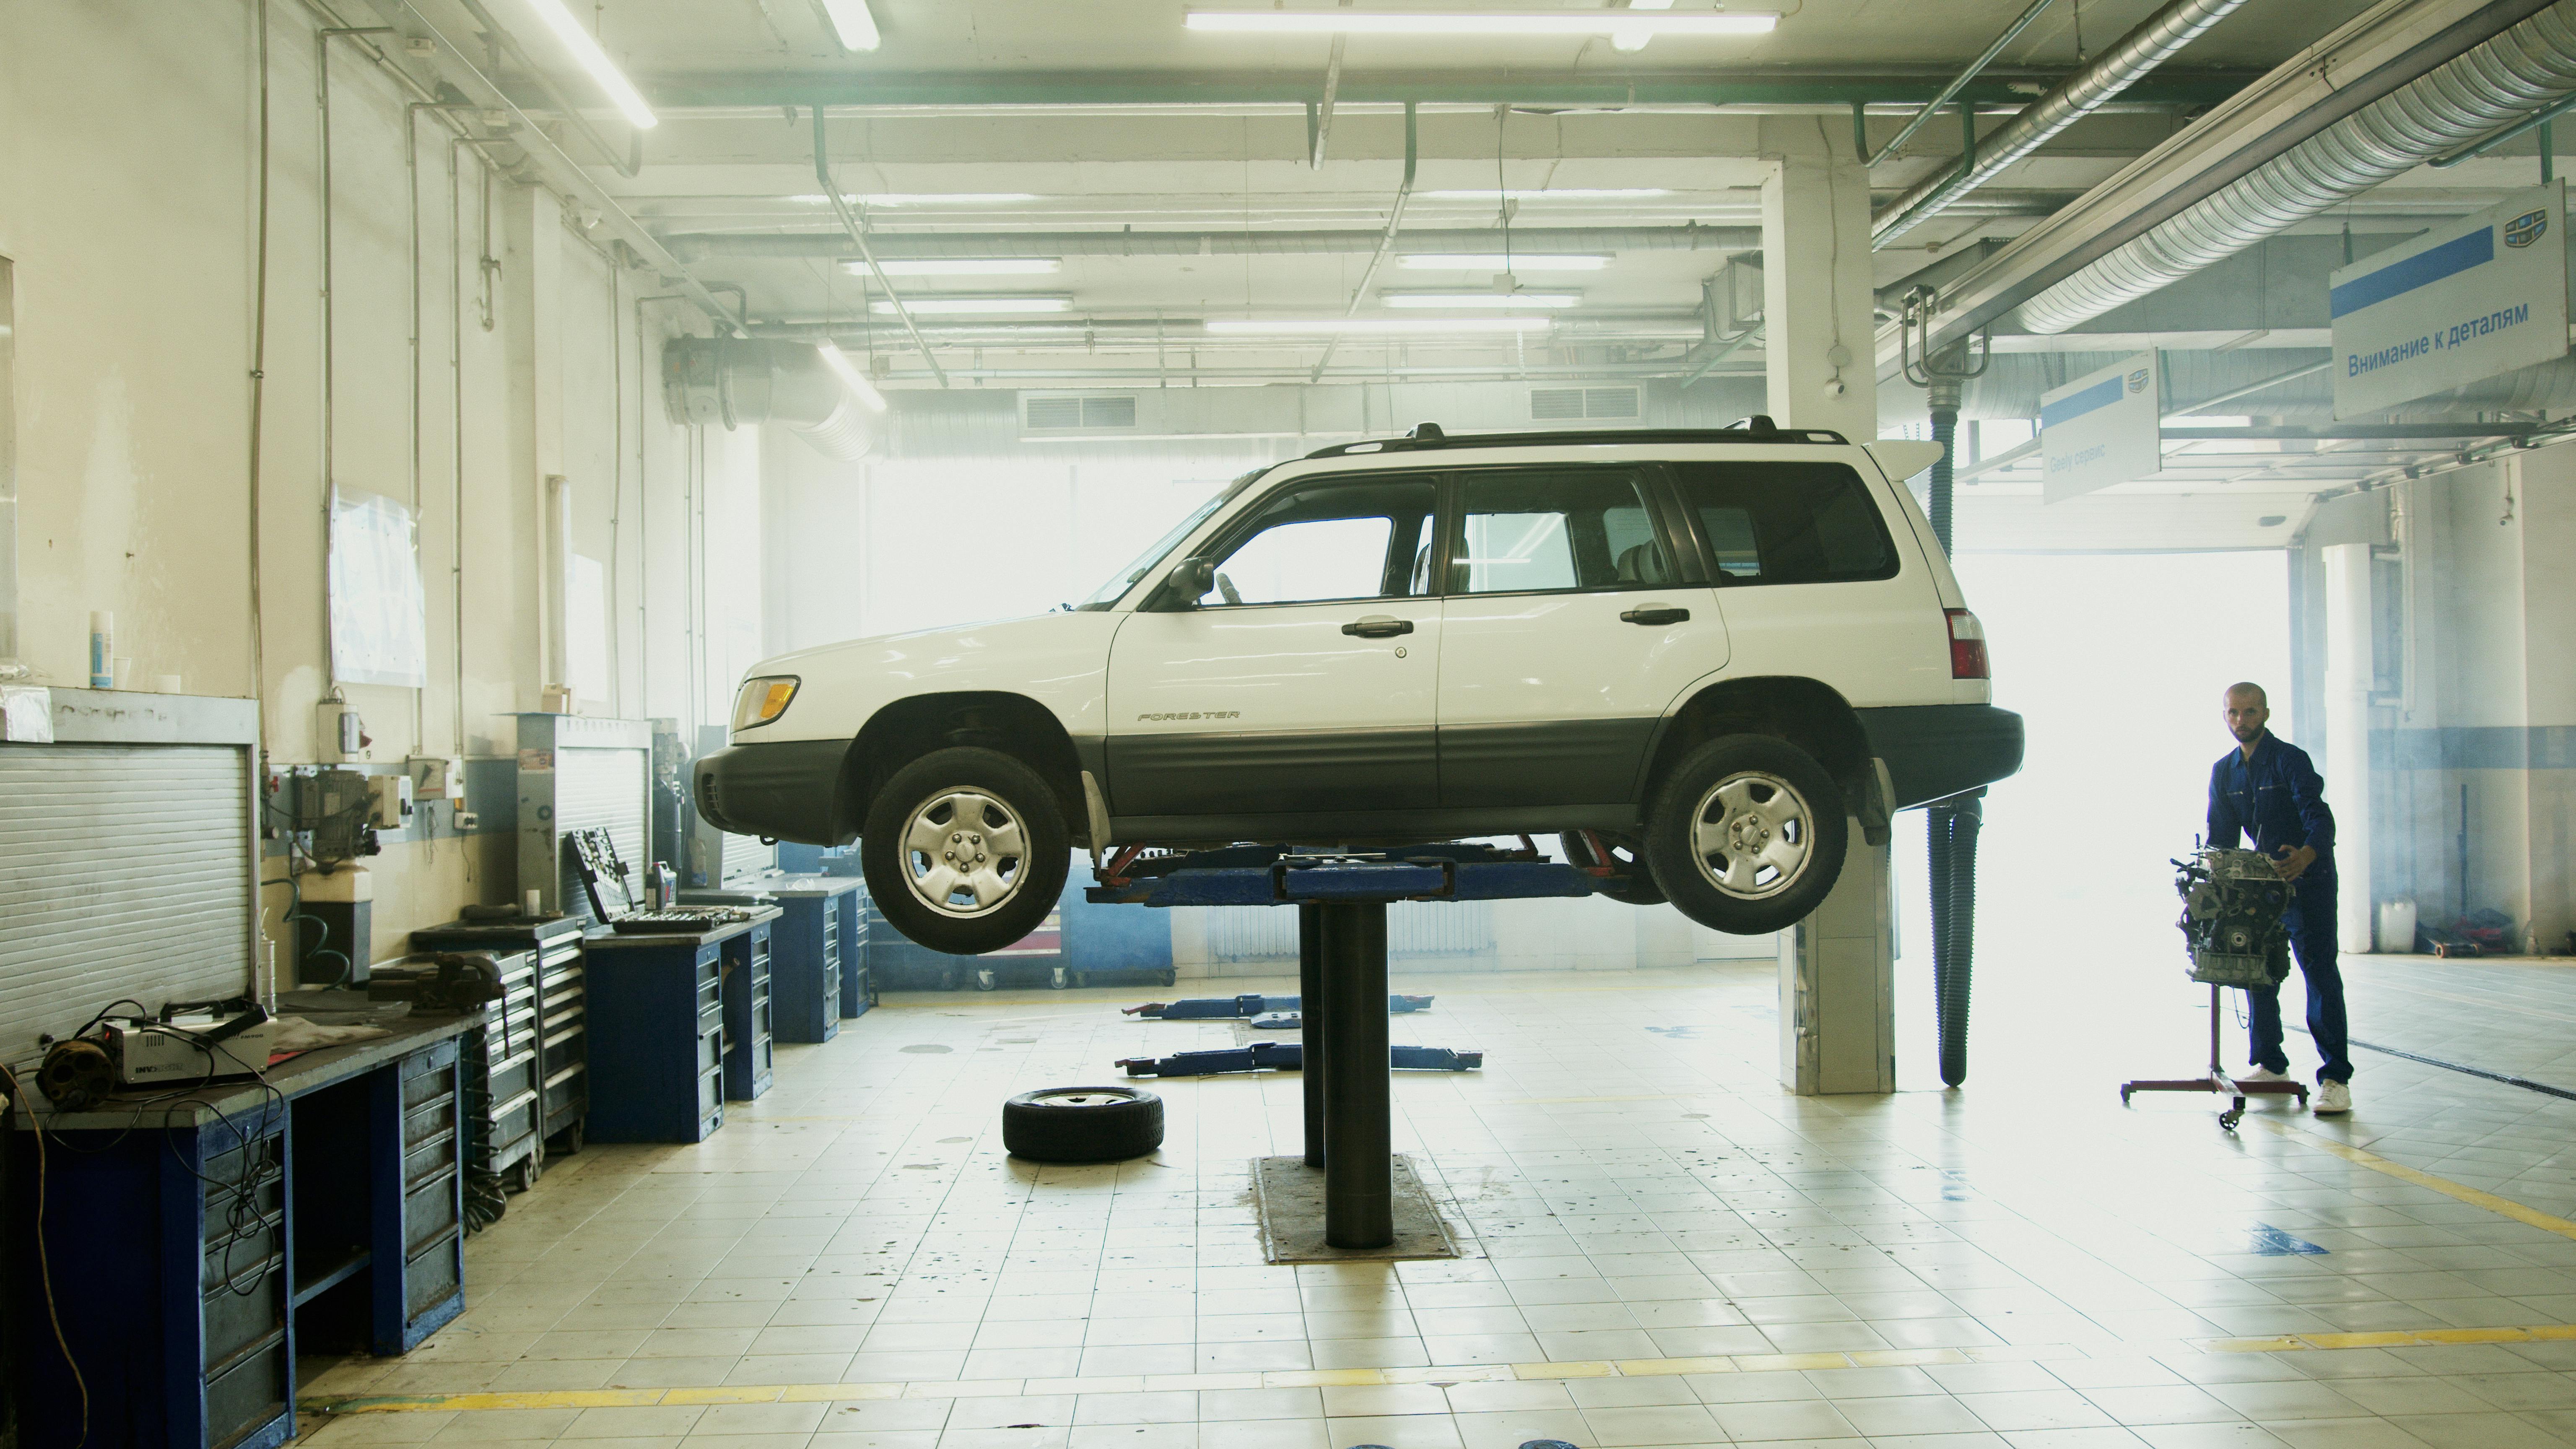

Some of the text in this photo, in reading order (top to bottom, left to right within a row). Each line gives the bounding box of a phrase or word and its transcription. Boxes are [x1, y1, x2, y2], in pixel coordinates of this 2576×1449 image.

[2349, 303, 2528, 378] Внимание к деталям
[2050, 444, 2106, 473] Geely сервис
[1137, 711, 1240, 721] FORESTER
